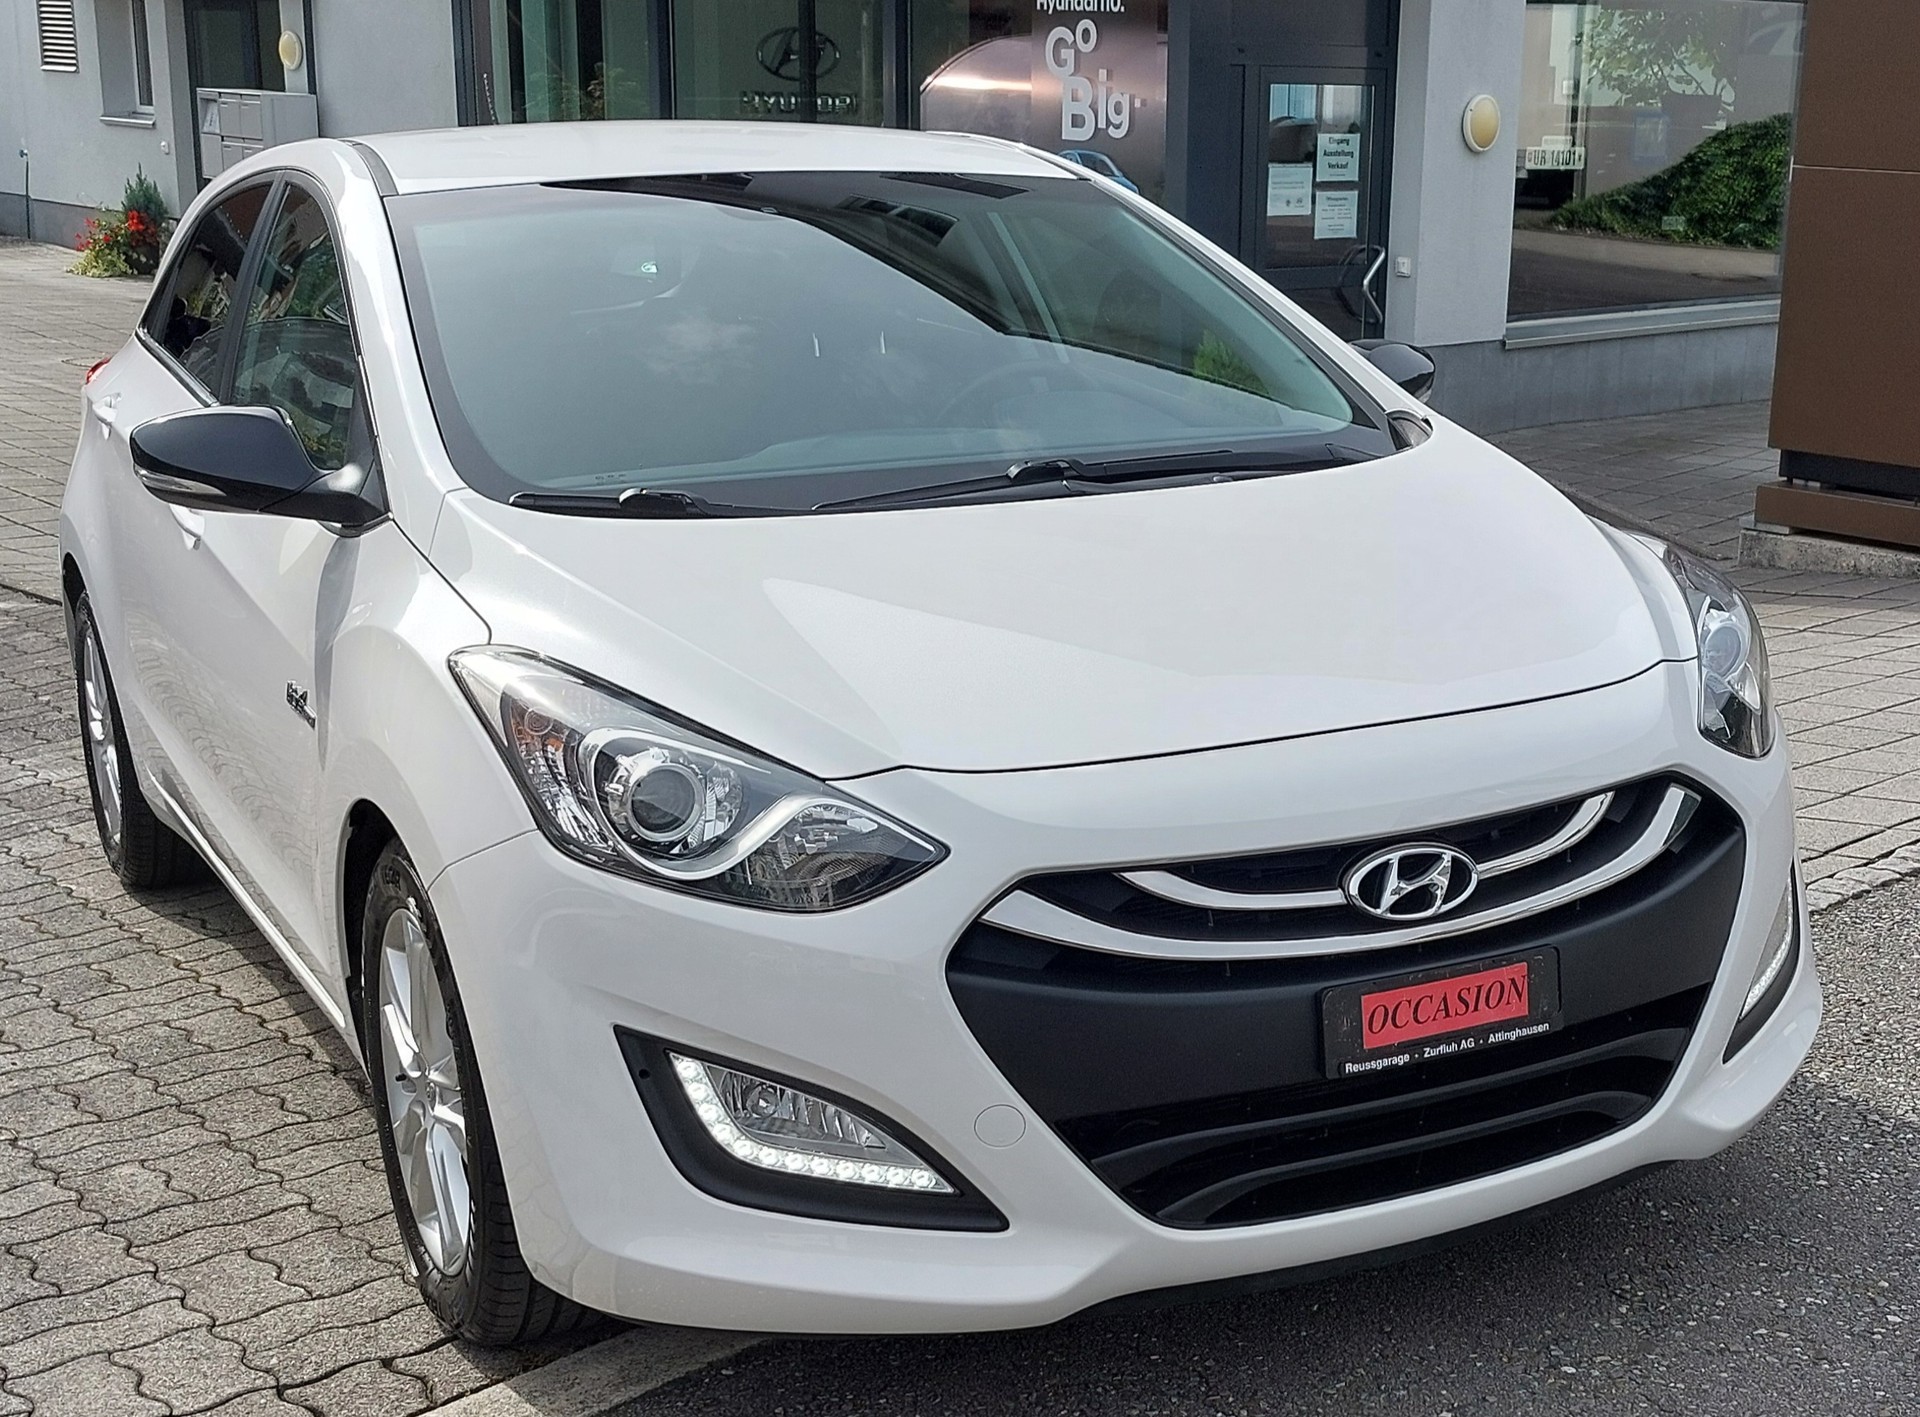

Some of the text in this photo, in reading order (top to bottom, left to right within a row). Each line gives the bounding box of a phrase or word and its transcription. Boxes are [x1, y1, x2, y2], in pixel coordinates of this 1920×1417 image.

[1045, 19, 1098, 77] Go
[1323, 149, 1354, 159] Ausstellung
[1327, 161, 1349, 169] Verkauf
[1533, 149, 1546, 166] UR
[1367, 974, 1528, 1035] OCCASION
[1345, 1022, 1550, 1074] Reussgarage Zurfluh AG Attinghausen
